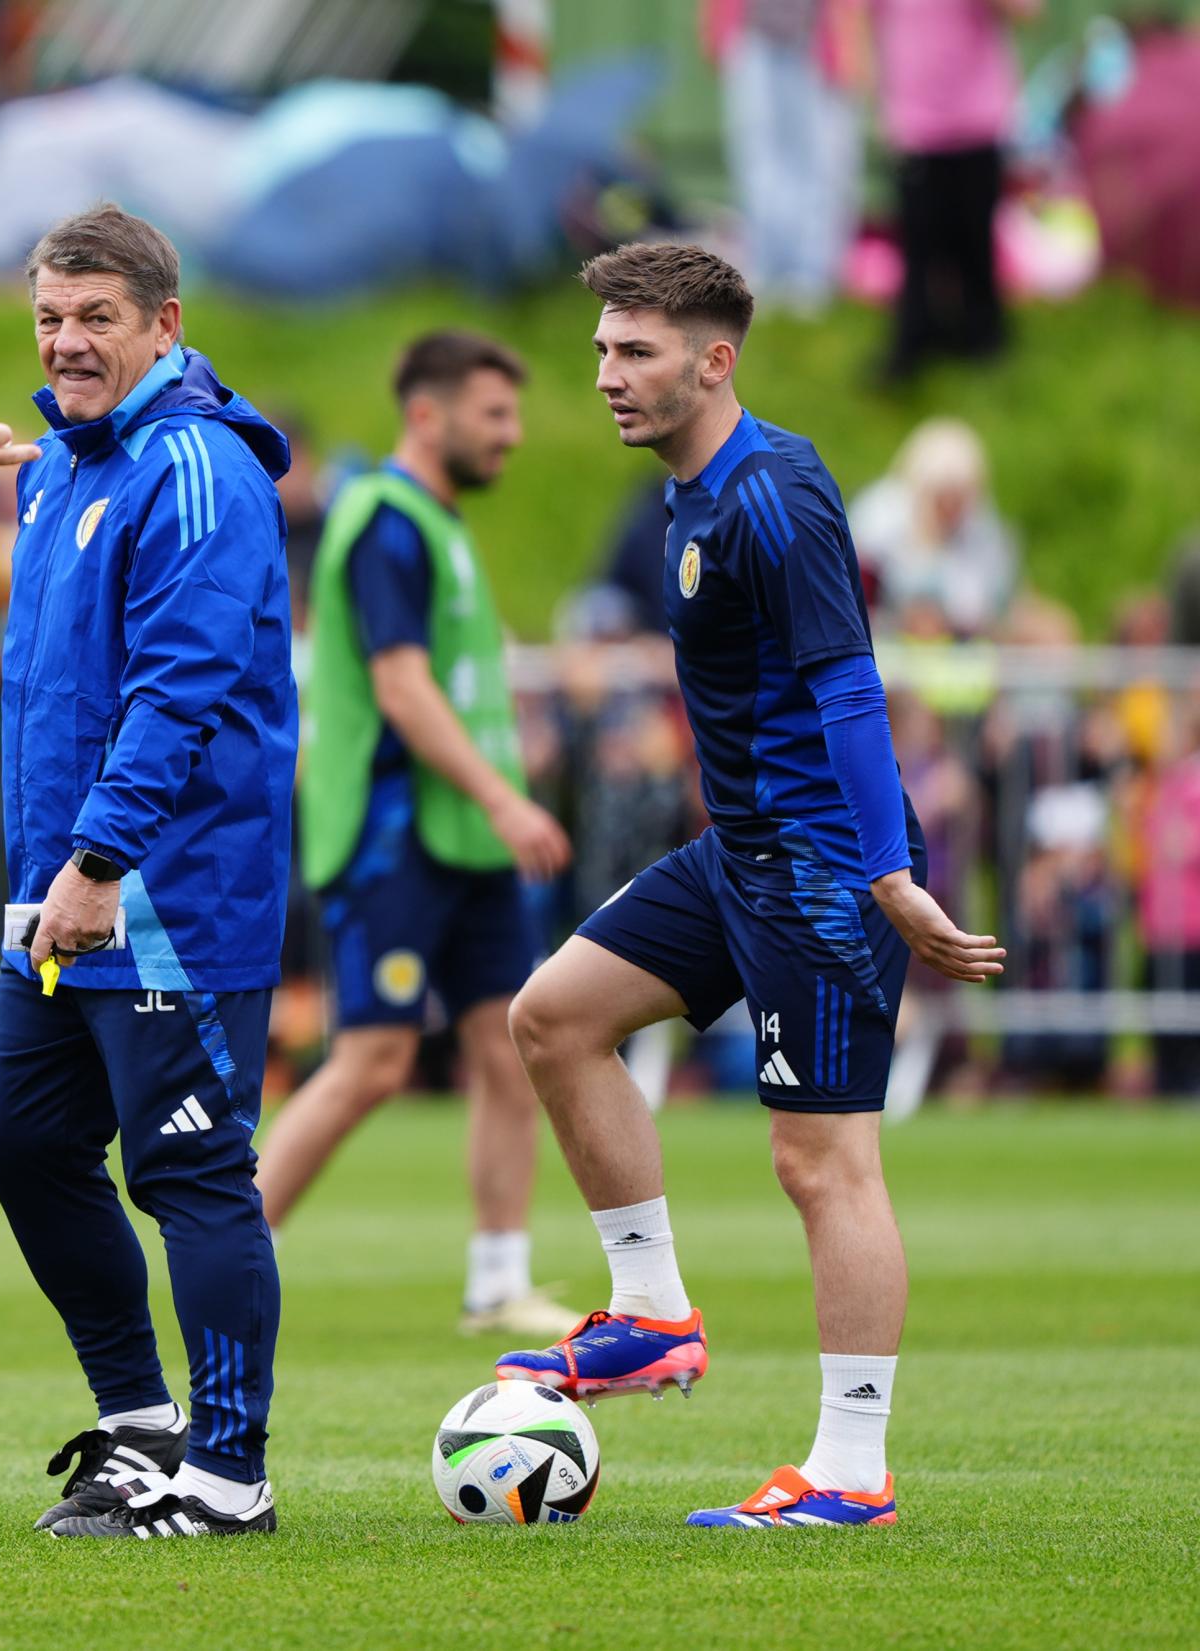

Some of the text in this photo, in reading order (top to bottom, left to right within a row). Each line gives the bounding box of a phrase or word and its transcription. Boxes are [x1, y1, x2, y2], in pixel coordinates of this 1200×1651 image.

[761, 1011, 781, 1043] 14
[844, 1391, 881, 1400] adidas
[559, 1467, 578, 1490] SCO
